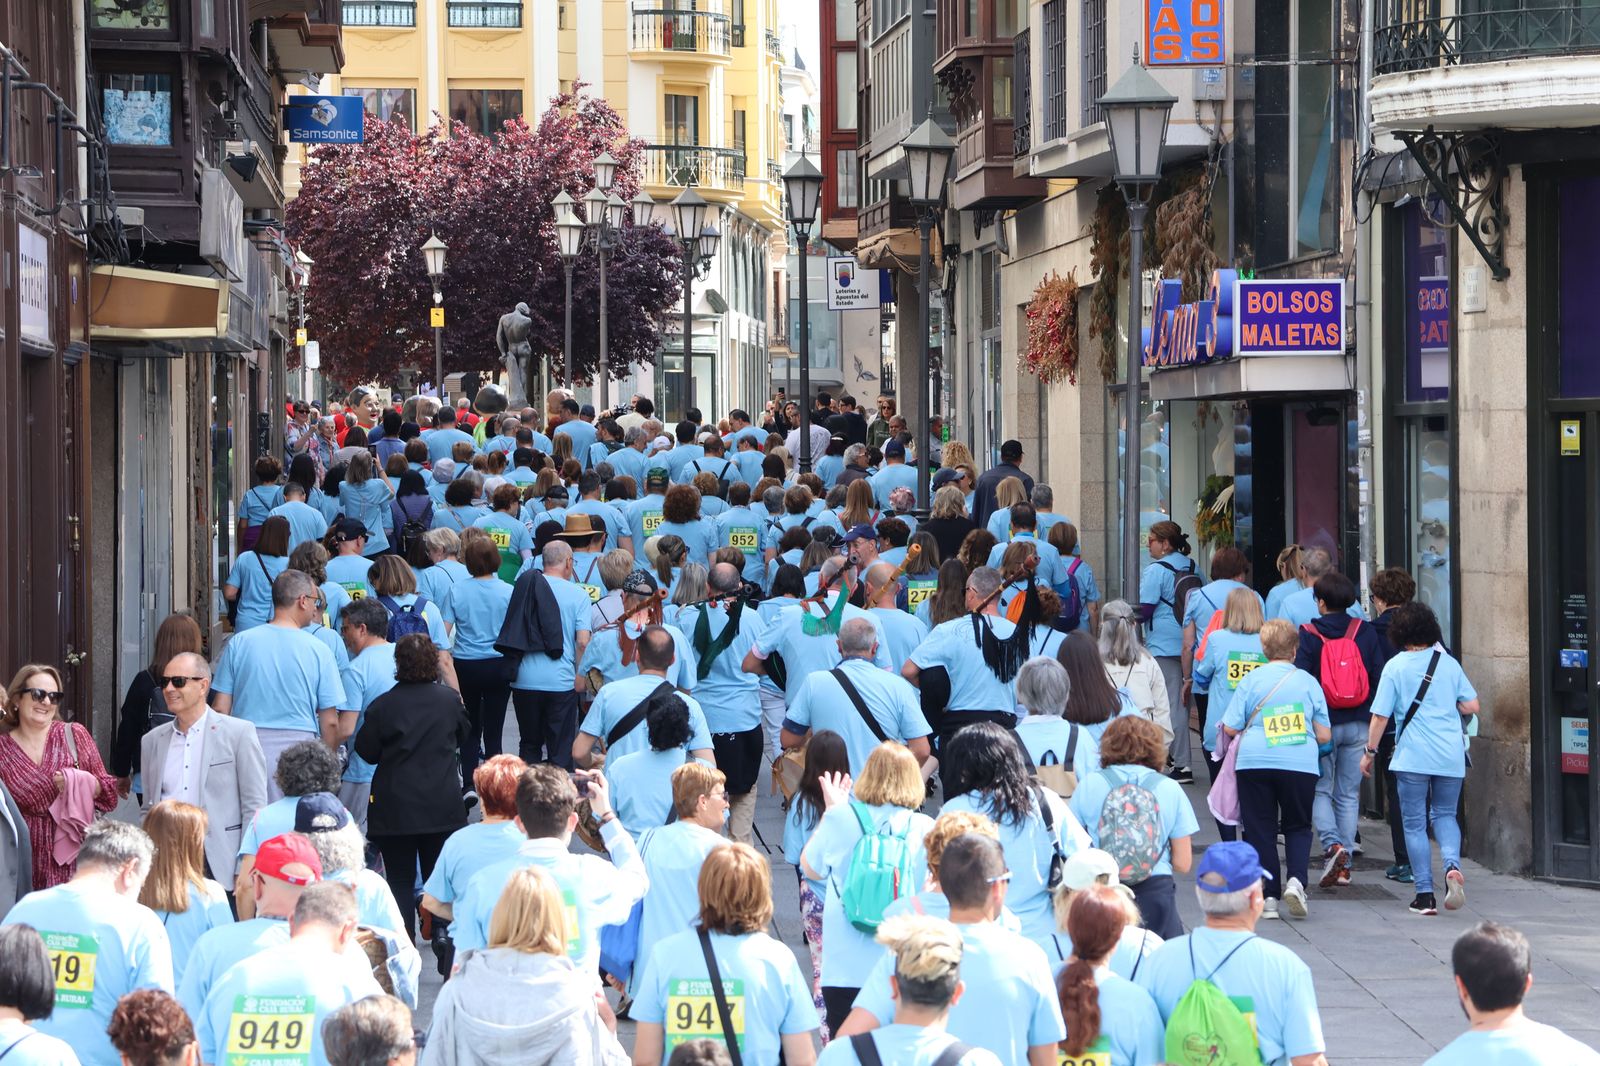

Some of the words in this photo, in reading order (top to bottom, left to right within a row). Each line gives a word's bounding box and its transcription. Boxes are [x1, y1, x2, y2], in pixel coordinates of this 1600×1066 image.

[1153, 0, 1182, 60] AS
[293, 128, 358, 139] Samsonite
[1247, 290, 1333, 314] BOLSOS
[1242, 322, 1340, 346] MALETAS
[646, 518, 665, 529] 95
[732, 534, 754, 545] 952
[911, 590, 936, 603] 27
[1229, 663, 1260, 678] 35
[1268, 714, 1302, 733] 494
[61, 993, 87, 1004] RURAL
[259, 997, 306, 1006] FUNDACIÓN
[259, 1005, 278, 1013] CAJA
[279, 1005, 305, 1013] RURAL
[239, 1020, 303, 1050] 949
[249, 1058, 272, 1066] CAJA
[273, 1058, 304, 1066] RURAL
